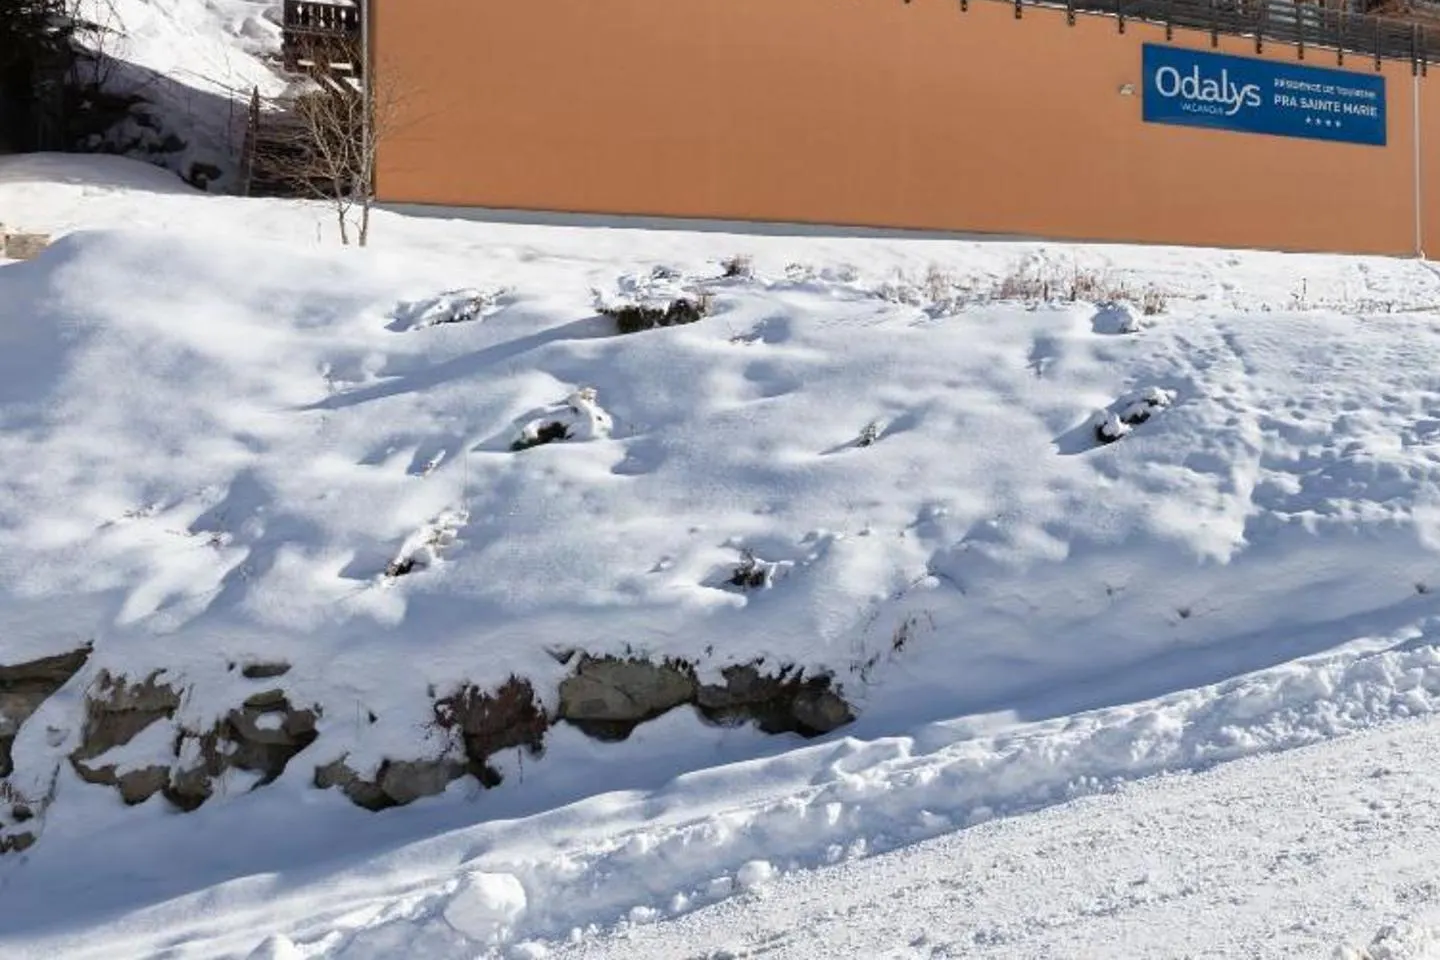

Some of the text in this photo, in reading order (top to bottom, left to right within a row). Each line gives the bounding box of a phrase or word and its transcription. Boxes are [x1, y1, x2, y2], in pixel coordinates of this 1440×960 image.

[1155, 65, 1261, 116] Odalys
[1274, 94, 1378, 118] PRA SAINTE MARIE
